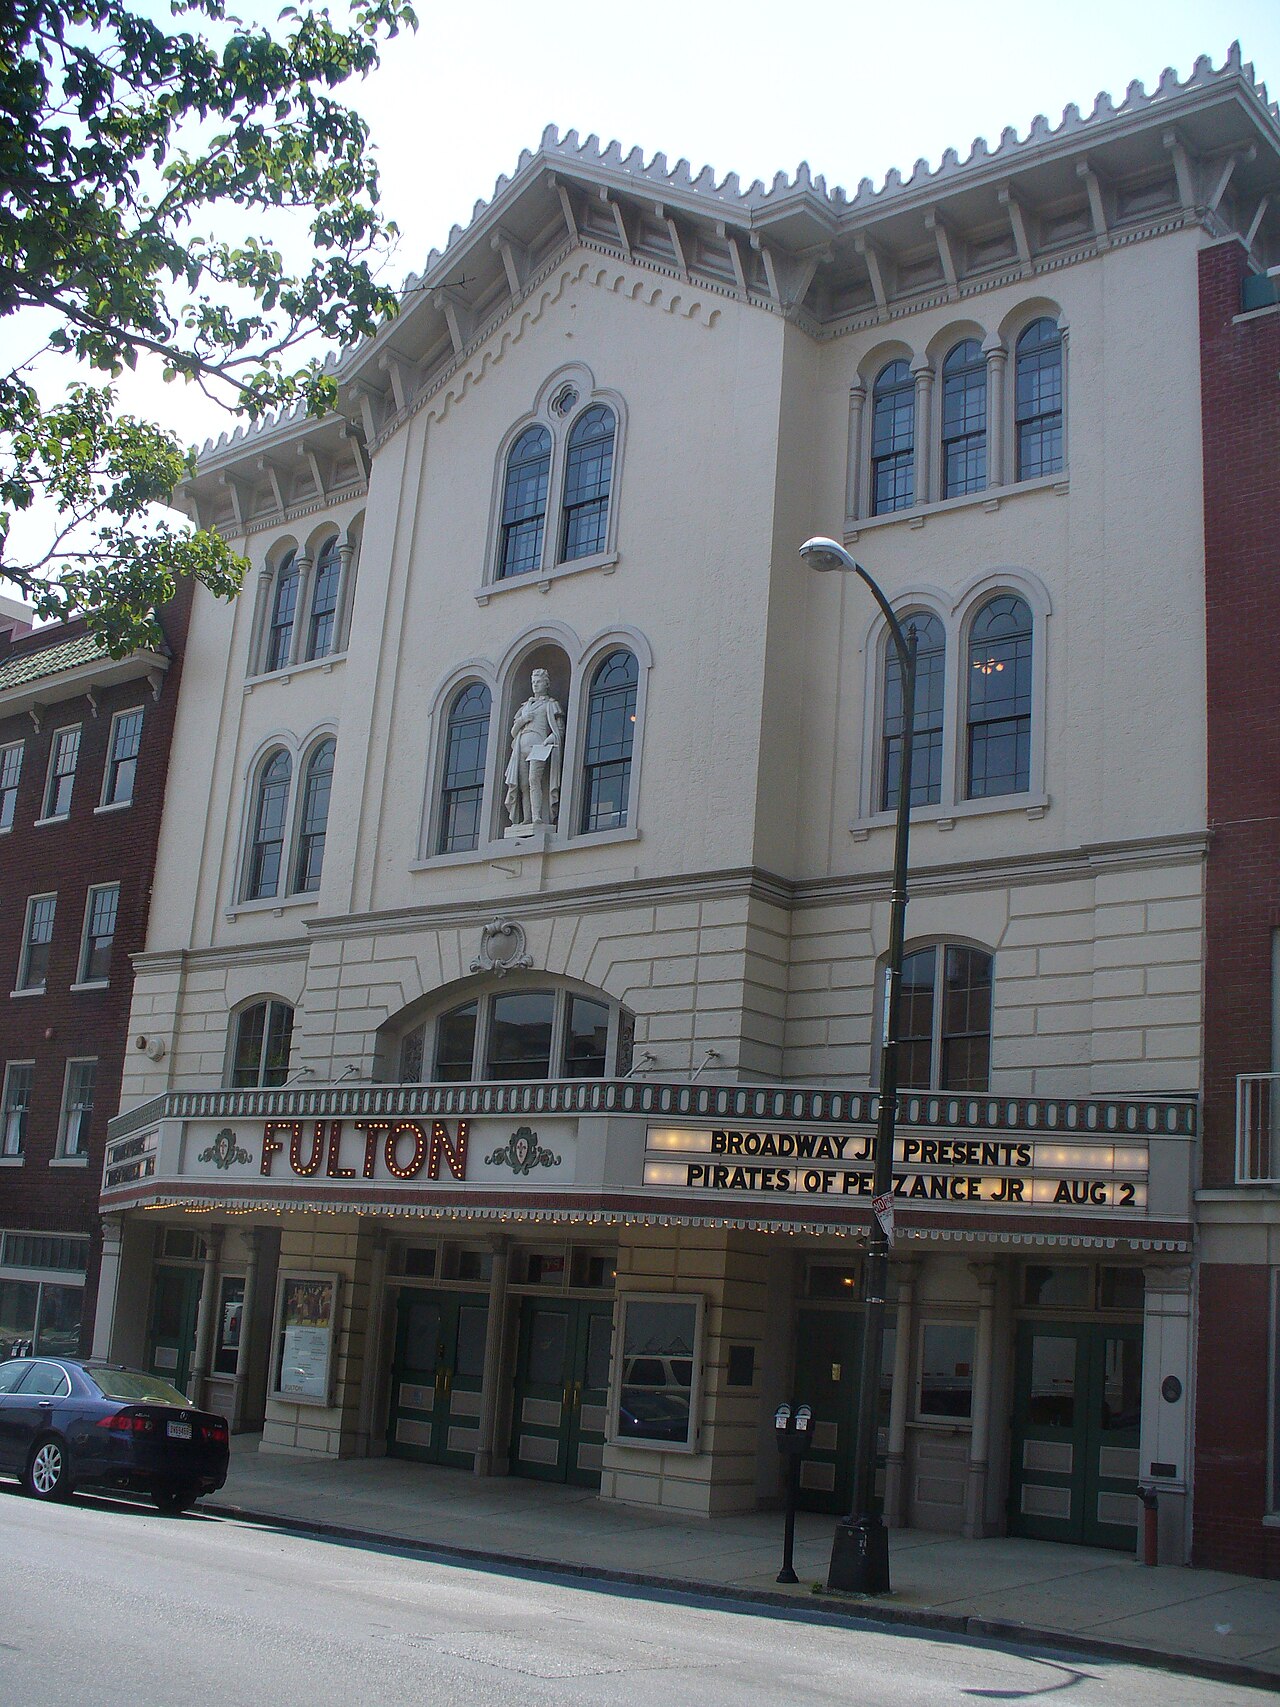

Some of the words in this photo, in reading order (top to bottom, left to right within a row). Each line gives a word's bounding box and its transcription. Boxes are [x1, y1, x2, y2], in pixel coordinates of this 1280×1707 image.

[260, 1119, 470, 1181] FULTON
[711, 1131, 850, 1159] BROADWAY
[854, 1137, 878, 1160] J
[903, 1139, 1031, 1167] PRESENTS
[687, 1164, 790, 1191] PIRATES
[804, 1170, 836, 1193] OF
[843, 1172, 981, 1200] PEZANCE
[990, 1177, 1024, 1201] JR
[1053, 1180, 1106, 1205] AUG
[1119, 1182, 1136, 1206] 2
